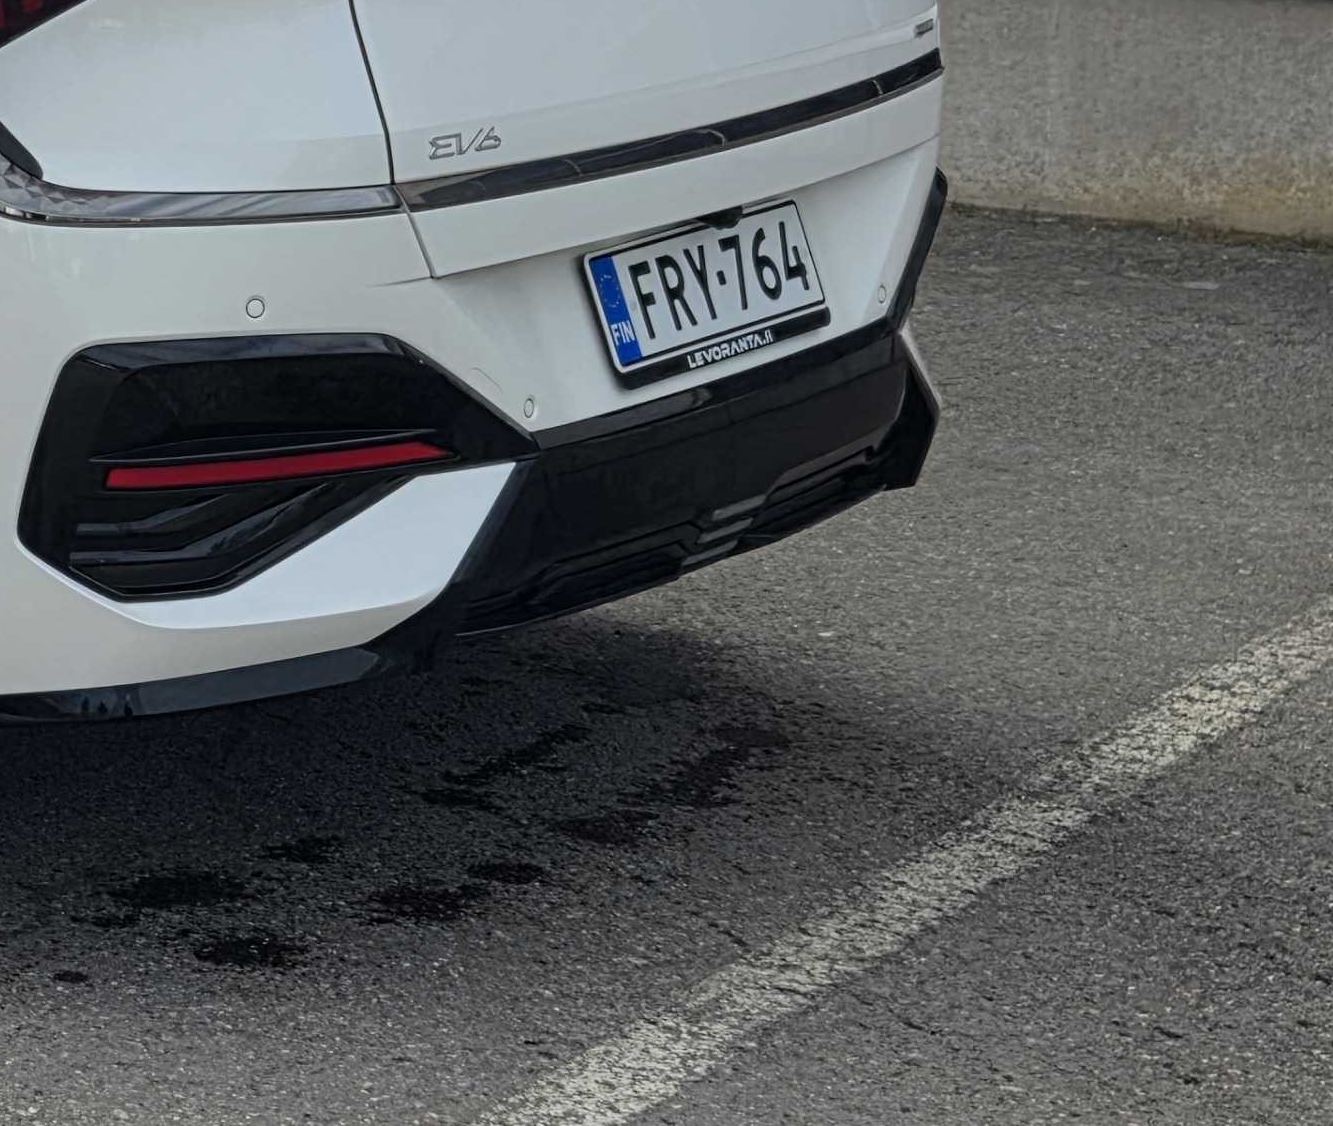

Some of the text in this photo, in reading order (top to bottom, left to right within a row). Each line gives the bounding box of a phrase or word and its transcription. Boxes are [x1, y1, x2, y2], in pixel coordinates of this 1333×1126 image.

[429, 127, 501, 159] EV6
[628, 222, 810, 340] FRY-764
[610, 320, 636, 347] FIN
